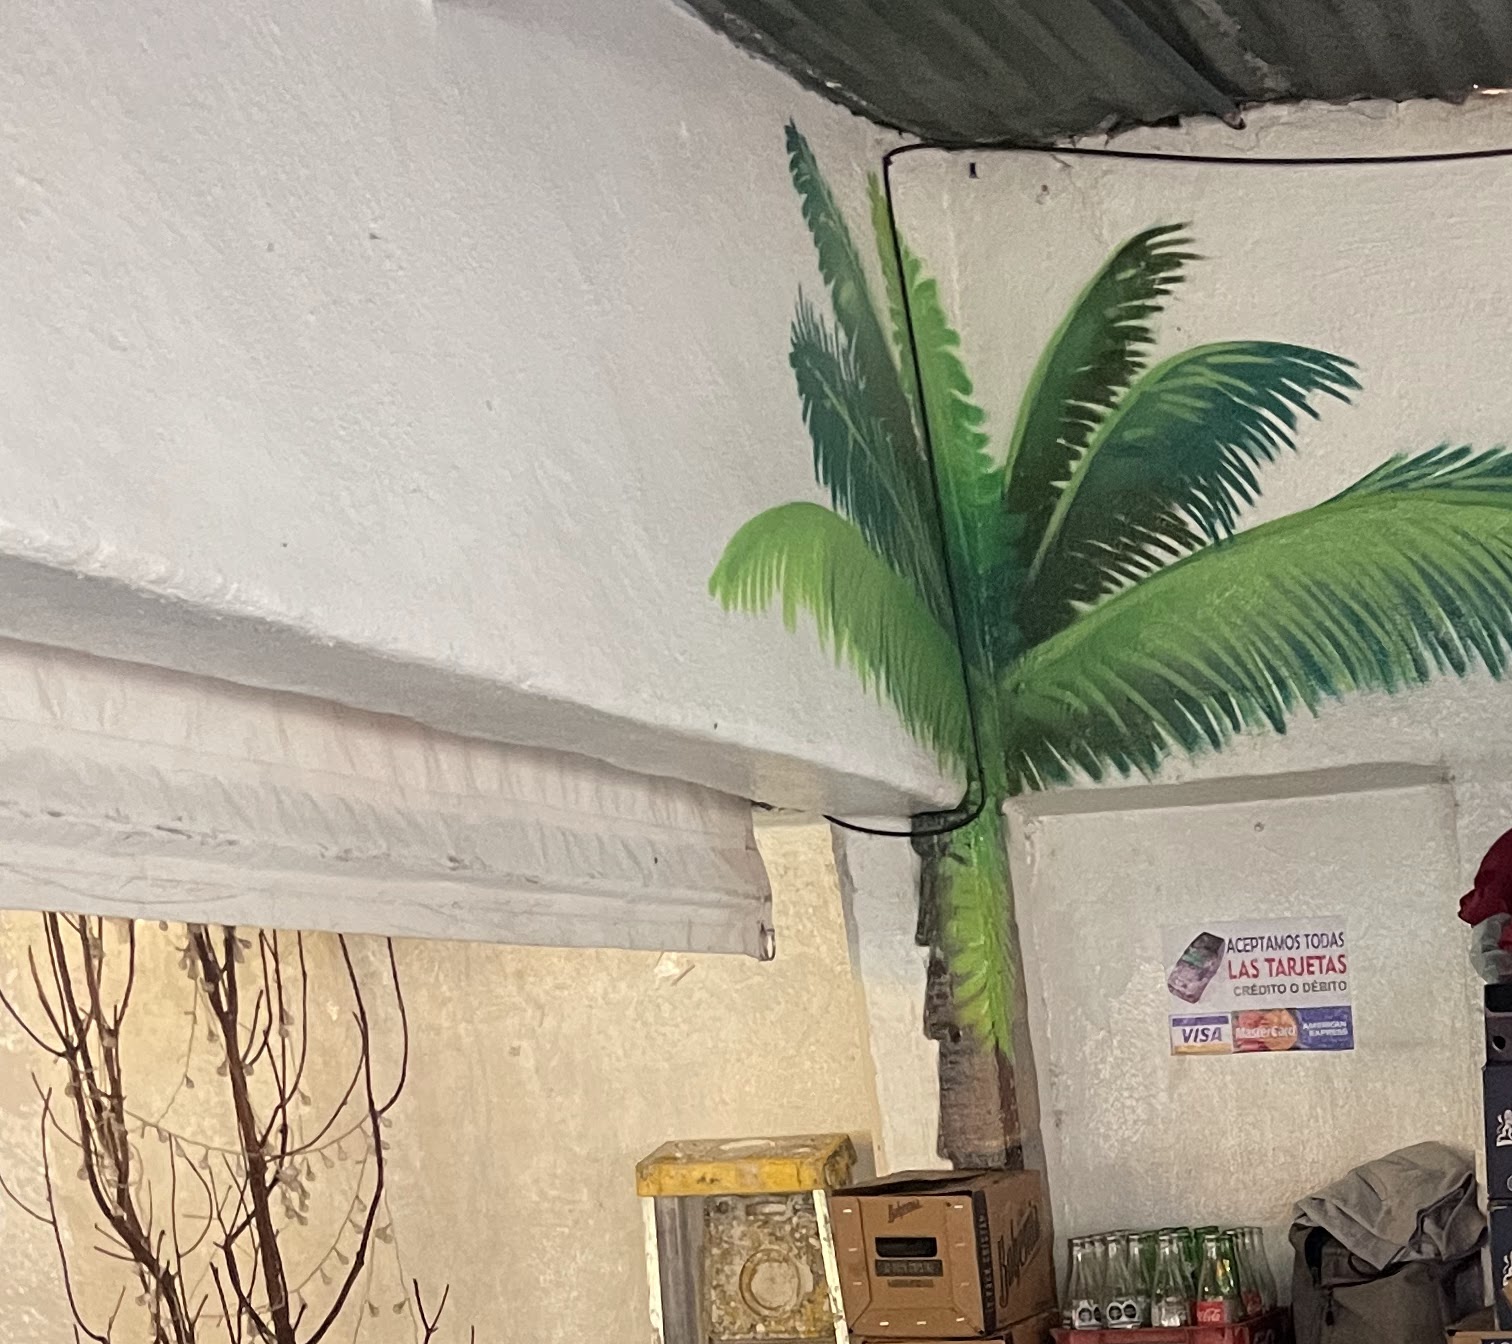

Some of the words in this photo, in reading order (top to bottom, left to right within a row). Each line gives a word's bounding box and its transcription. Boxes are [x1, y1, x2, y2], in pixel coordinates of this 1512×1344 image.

[1226, 934, 1300, 954] ACEPTAMOS
[1304, 931, 1345, 949] TODAS
[1227, 959, 1260, 980] LAS
[1264, 954, 1348, 978] TARJETAS
[1233, 981, 1287, 997] CRÉDITO
[1290, 982, 1300, 994] O
[1302, 979, 1347, 993] DÉBITO
[1182, 1027, 1223, 1044] VISA
[1235, 1024, 1296, 1040] MasterCard
